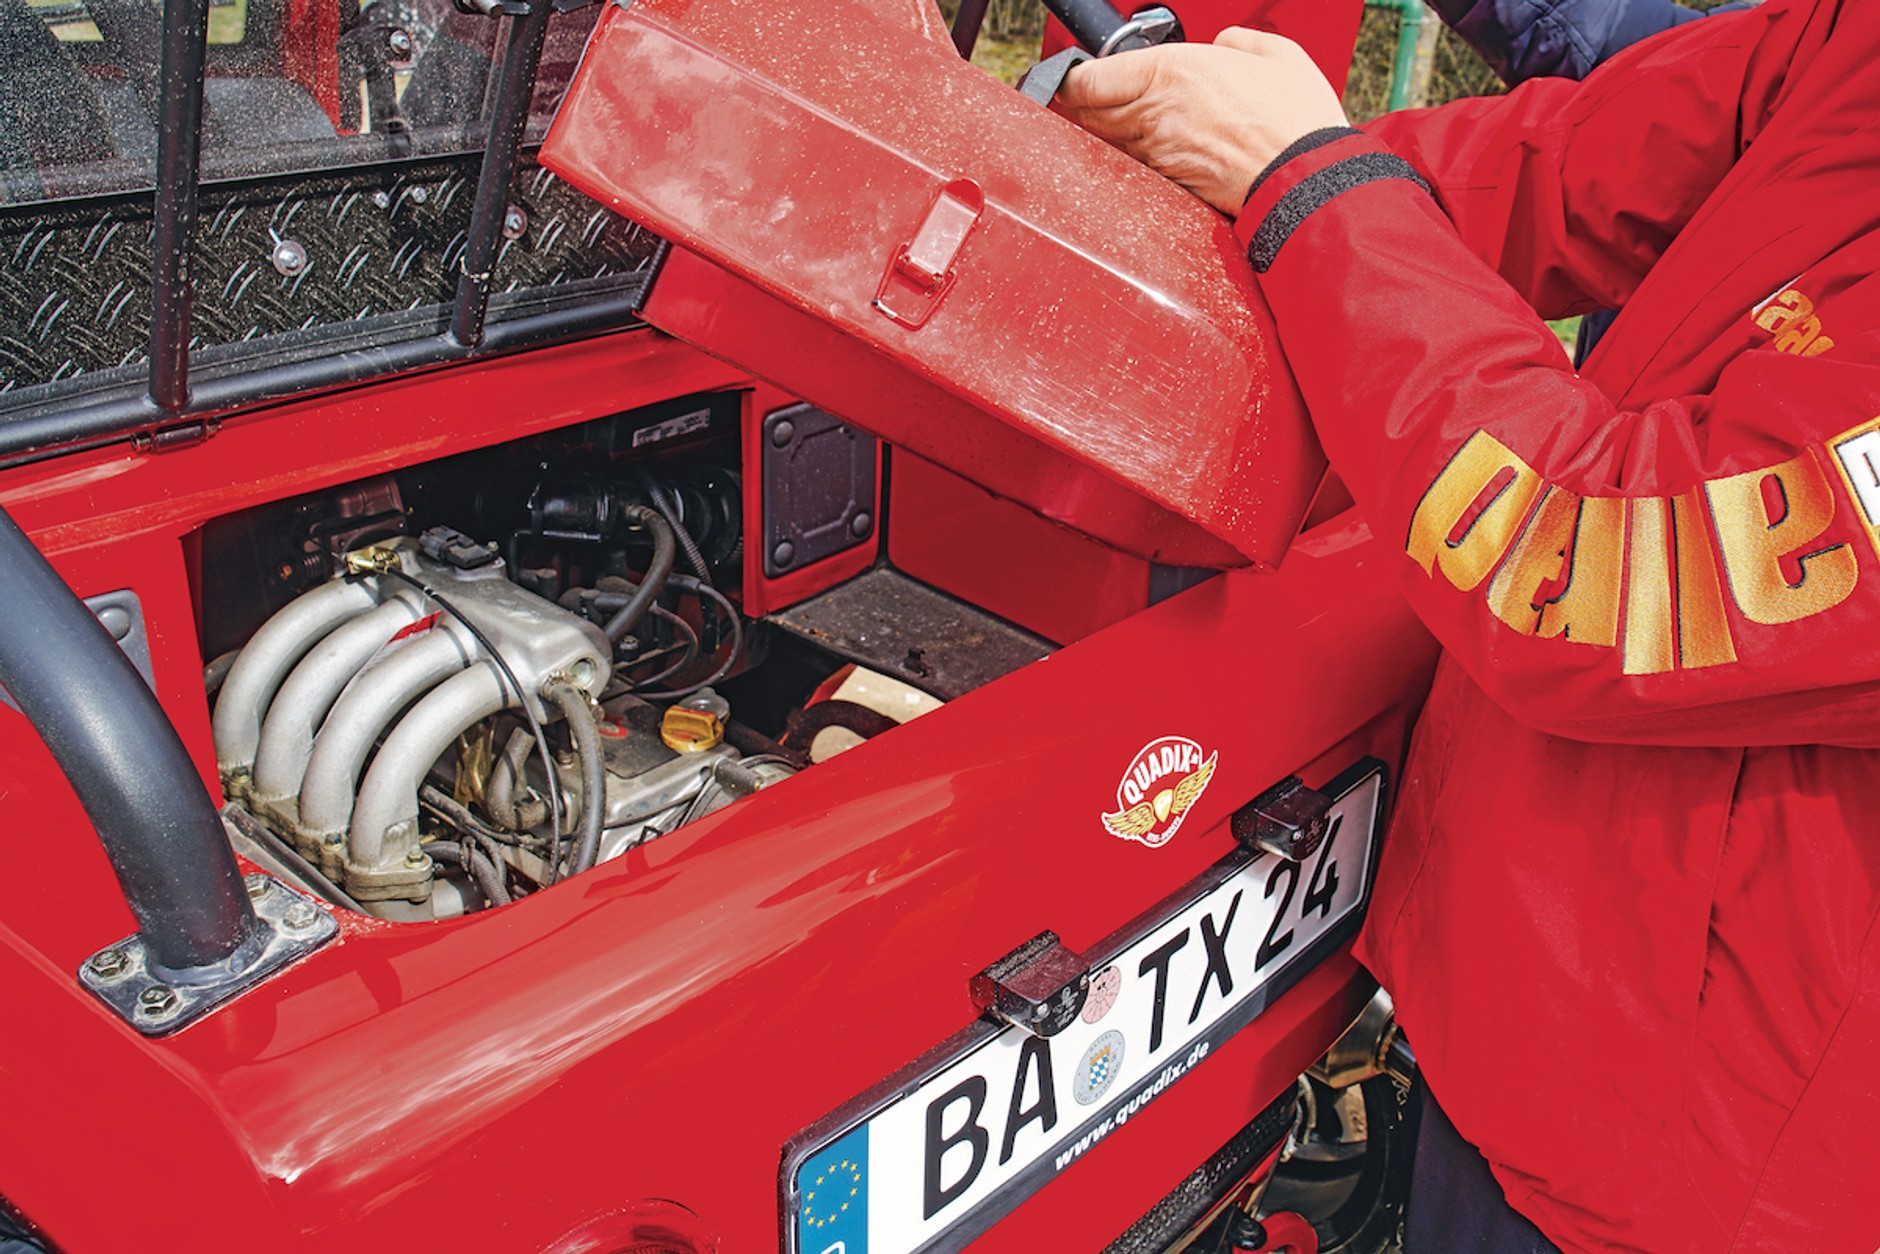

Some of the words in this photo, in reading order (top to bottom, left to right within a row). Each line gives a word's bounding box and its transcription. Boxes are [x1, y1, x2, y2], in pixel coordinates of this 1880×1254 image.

[923, 1034, 1058, 1221] BA
[1138, 888, 1243, 1054] TX
[1254, 814, 1343, 973] 24
[1055, 1042, 1210, 1170] www.quadix.de
